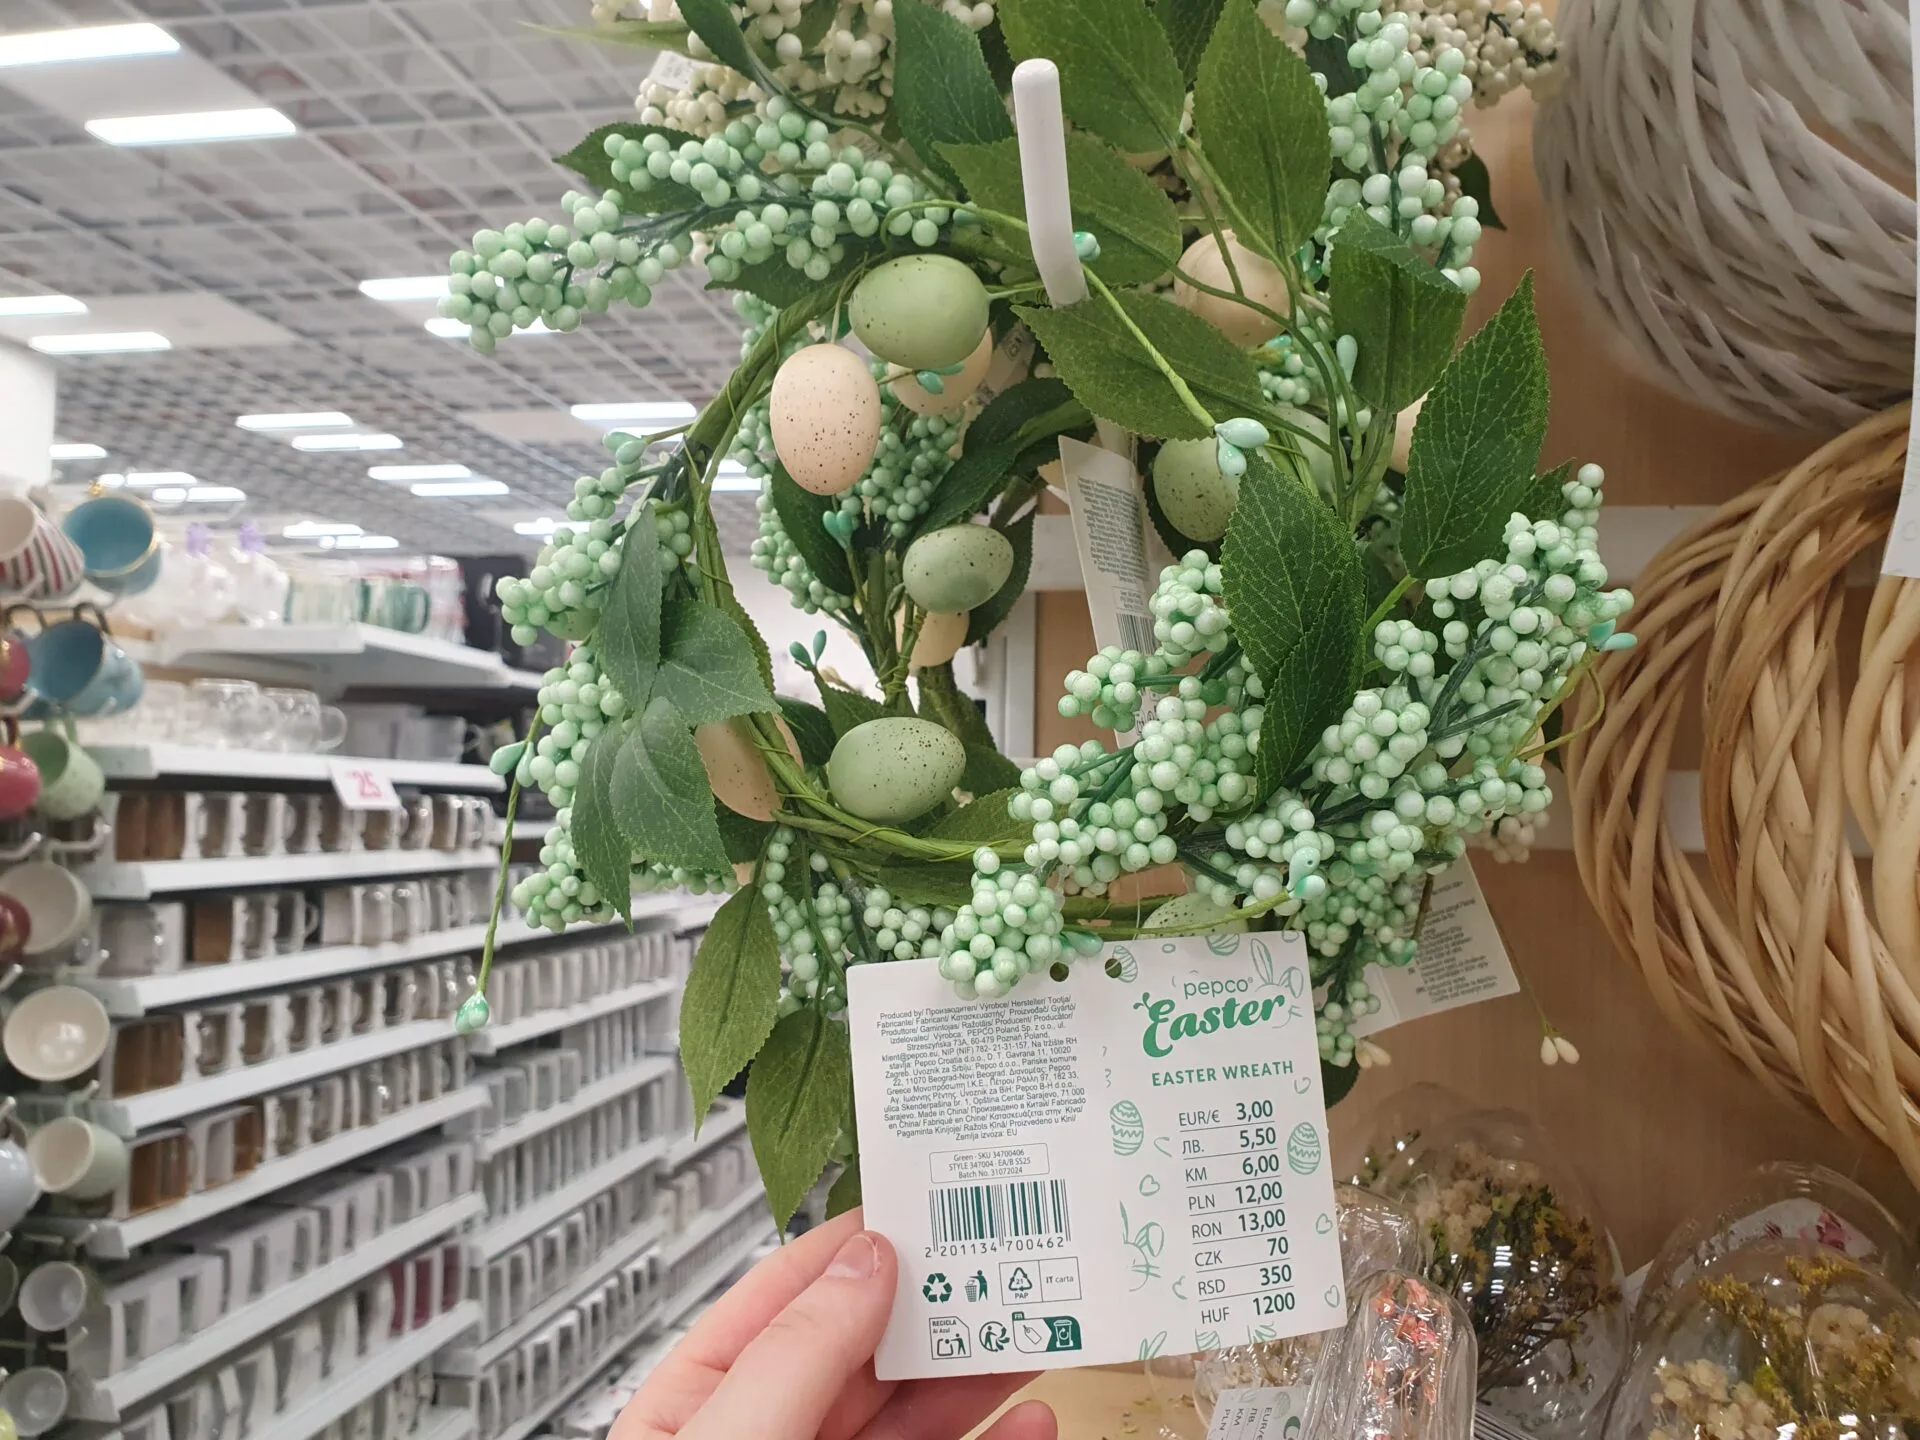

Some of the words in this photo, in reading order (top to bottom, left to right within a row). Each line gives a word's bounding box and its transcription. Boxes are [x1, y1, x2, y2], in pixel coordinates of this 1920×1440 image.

[1184, 978, 1249, 1000] pepco
[1142, 993, 1286, 1058] Easter
[1152, 1068, 1217, 1086] EASTER
[1222, 1060, 1294, 1080] WREATH
[1178, 1109, 1220, 1126] EUR/€
[1236, 1100, 1274, 1122] 3,00
[1240, 1126, 1276, 1150] 5,50
[948, 1162, 968, 1172] STYLE
[970, 1160, 994, 1170] 347004
[1016, 1157, 1030, 1165] SS25
[954, 1152, 974, 1162] Green
[978, 1152, 991, 1160] SKU
[993, 1148, 1024, 1158] 34700406
[1186, 1166, 1208, 1182] KM
[1242, 1154, 1280, 1176] 6,00
[958, 1168, 976, 1178] Batch
[992, 1166, 1023, 1176] 31072024
[1188, 1194, 1216, 1210] PLN
[1235, 1181, 1282, 1204] 12,00
[1192, 1221, 1222, 1239] RON
[1238, 1208, 1286, 1232] 13,00
[925, 1246, 932, 1258] 2
[940, 1242, 998, 1257] 201134
[1006, 1236, 1064, 1252] 700462
[1194, 1250, 1222, 1267] CZK
[1266, 1236, 1288, 1256] 70
[1198, 1278, 1226, 1296] RSD
[1260, 1264, 1292, 1286] 350
[1202, 1306, 1230, 1324] HUF
[1252, 1292, 1296, 1316] 1200
[1219, 1408, 1231, 1431] PLN
[1233, 1408, 1244, 1426] KM
